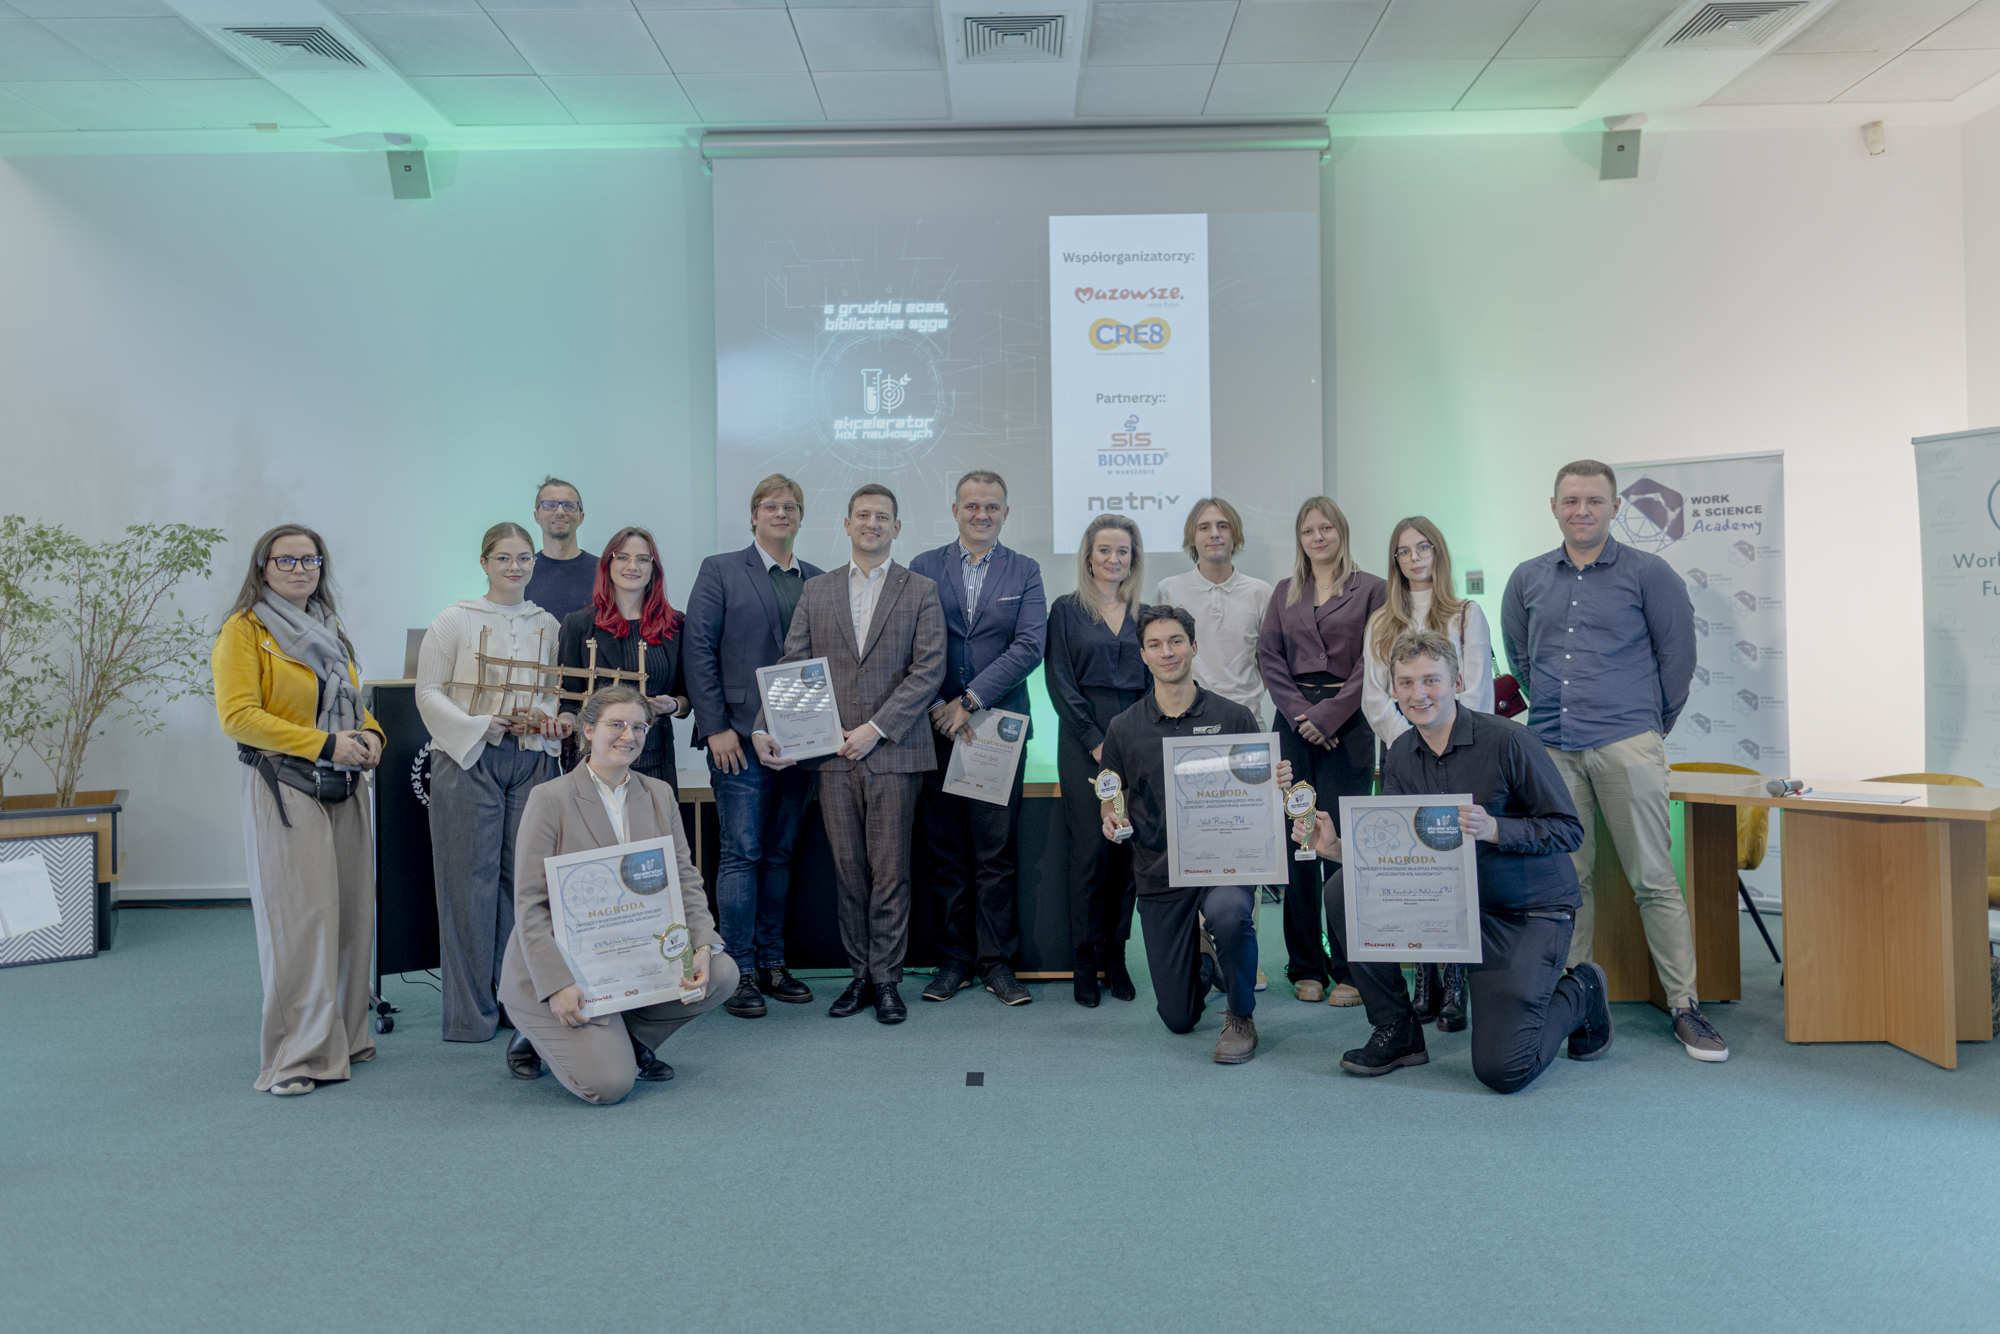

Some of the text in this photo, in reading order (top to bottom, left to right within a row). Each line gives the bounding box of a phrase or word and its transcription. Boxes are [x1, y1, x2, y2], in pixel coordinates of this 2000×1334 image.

[1063, 250, 1195, 265] Współorganizatorzy:
[838, 300, 901, 317] grudnia
[825, 317, 904, 330] biblioteka
[1095, 323, 1164, 345] CRE8
[1096, 393, 1166, 406] Partnerzy::
[834, 415, 934, 429] akcelerator
[835, 428, 933, 441] kół naukowych
[1690, 494, 1730, 505] WORK
[1692, 505, 1762, 518] & SCIENCE
[1692, 518, 1762, 535] Academy
[1197, 789, 1248, 798] NAGRODA
[1378, 856, 1436, 864] NAGRODA
[588, 901, 645, 919] NAGRODA
